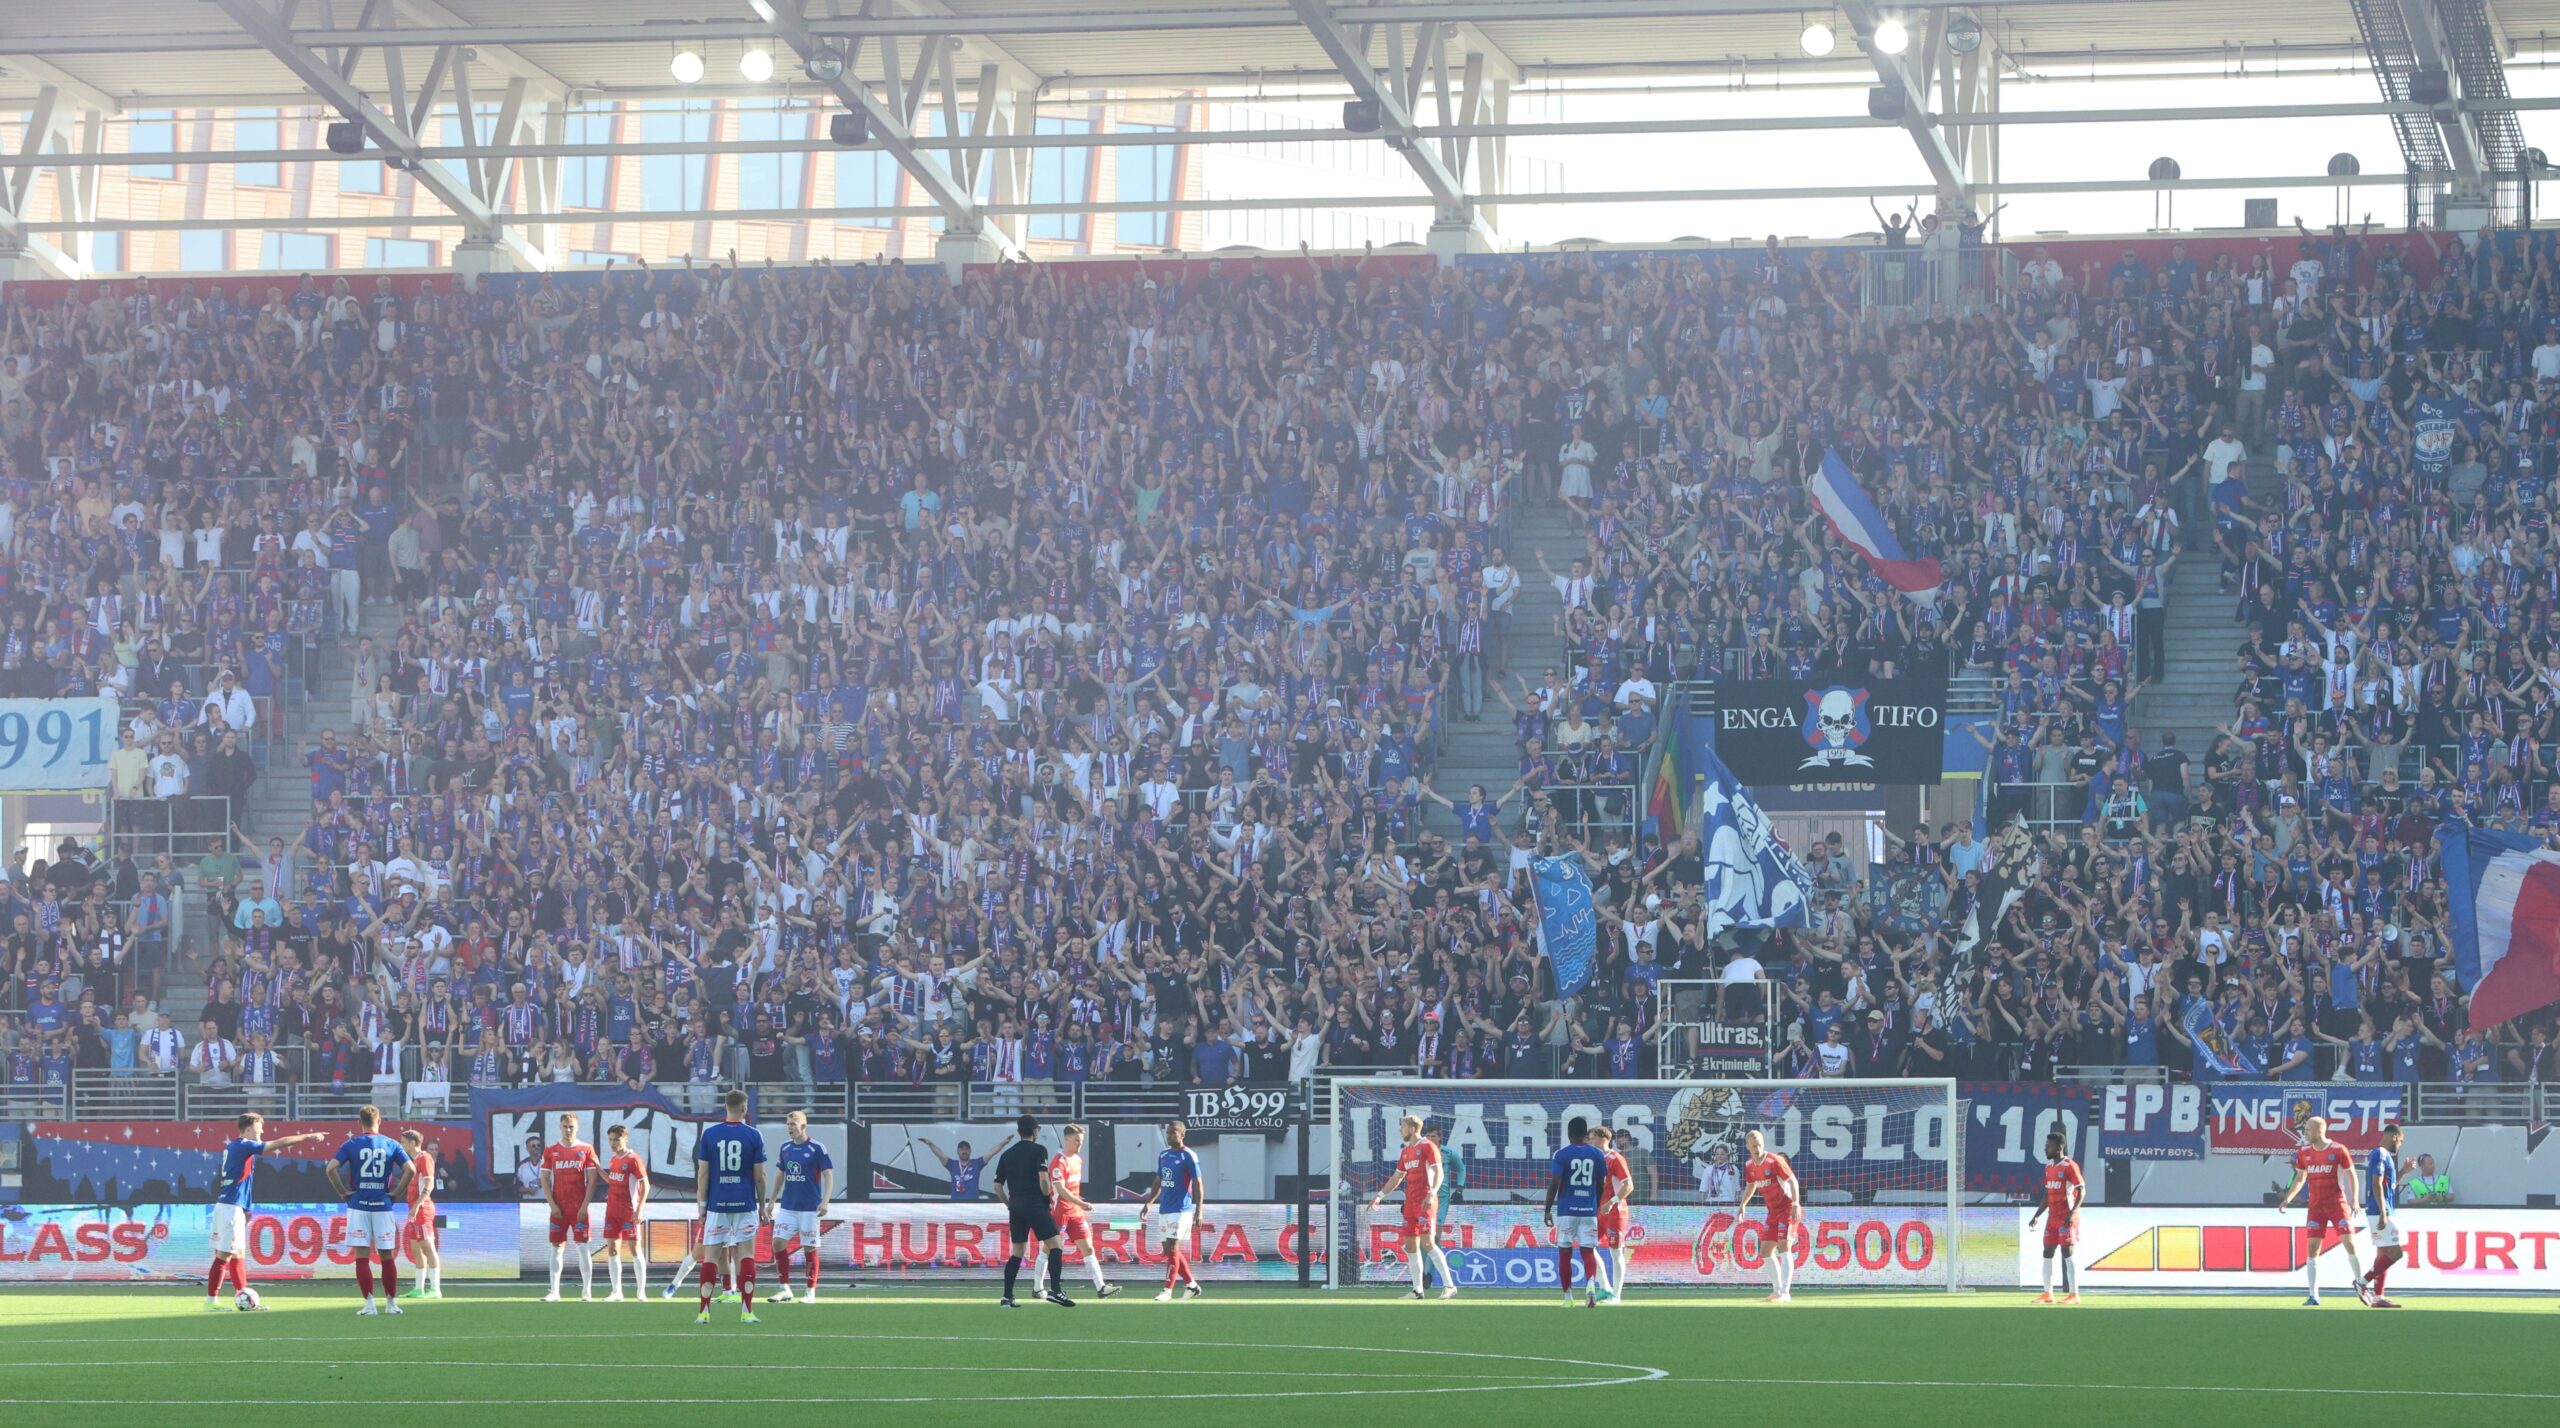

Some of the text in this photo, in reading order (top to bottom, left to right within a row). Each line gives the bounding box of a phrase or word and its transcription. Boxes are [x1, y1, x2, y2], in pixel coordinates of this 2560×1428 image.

[1765, 267, 1778, 284] 71
[1568, 402, 1582, 419] 12
[1722, 705, 1938, 730] ENGA TIFO
[0, 708, 108, 770] 991
[1700, 1022, 1763, 1048] Ultras,
[1710, 1056, 1762, 1071] kriminelle
[2104, 1085, 2201, 1132] EPB
[2211, 1098, 2282, 1135] YNG
[1188, 1117, 1284, 1128] VÅLERENGA OSLO
[359, 1147, 387, 1178] 23
[717, 1139, 743, 1172] 18
[2105, 1146, 2194, 1158] ENGA PARTY BOYS
[786, 1174, 806, 1182] OBOS
[1569, 1158, 1595, 1186] 29
[1504, 1257, 1590, 1284] OBO
